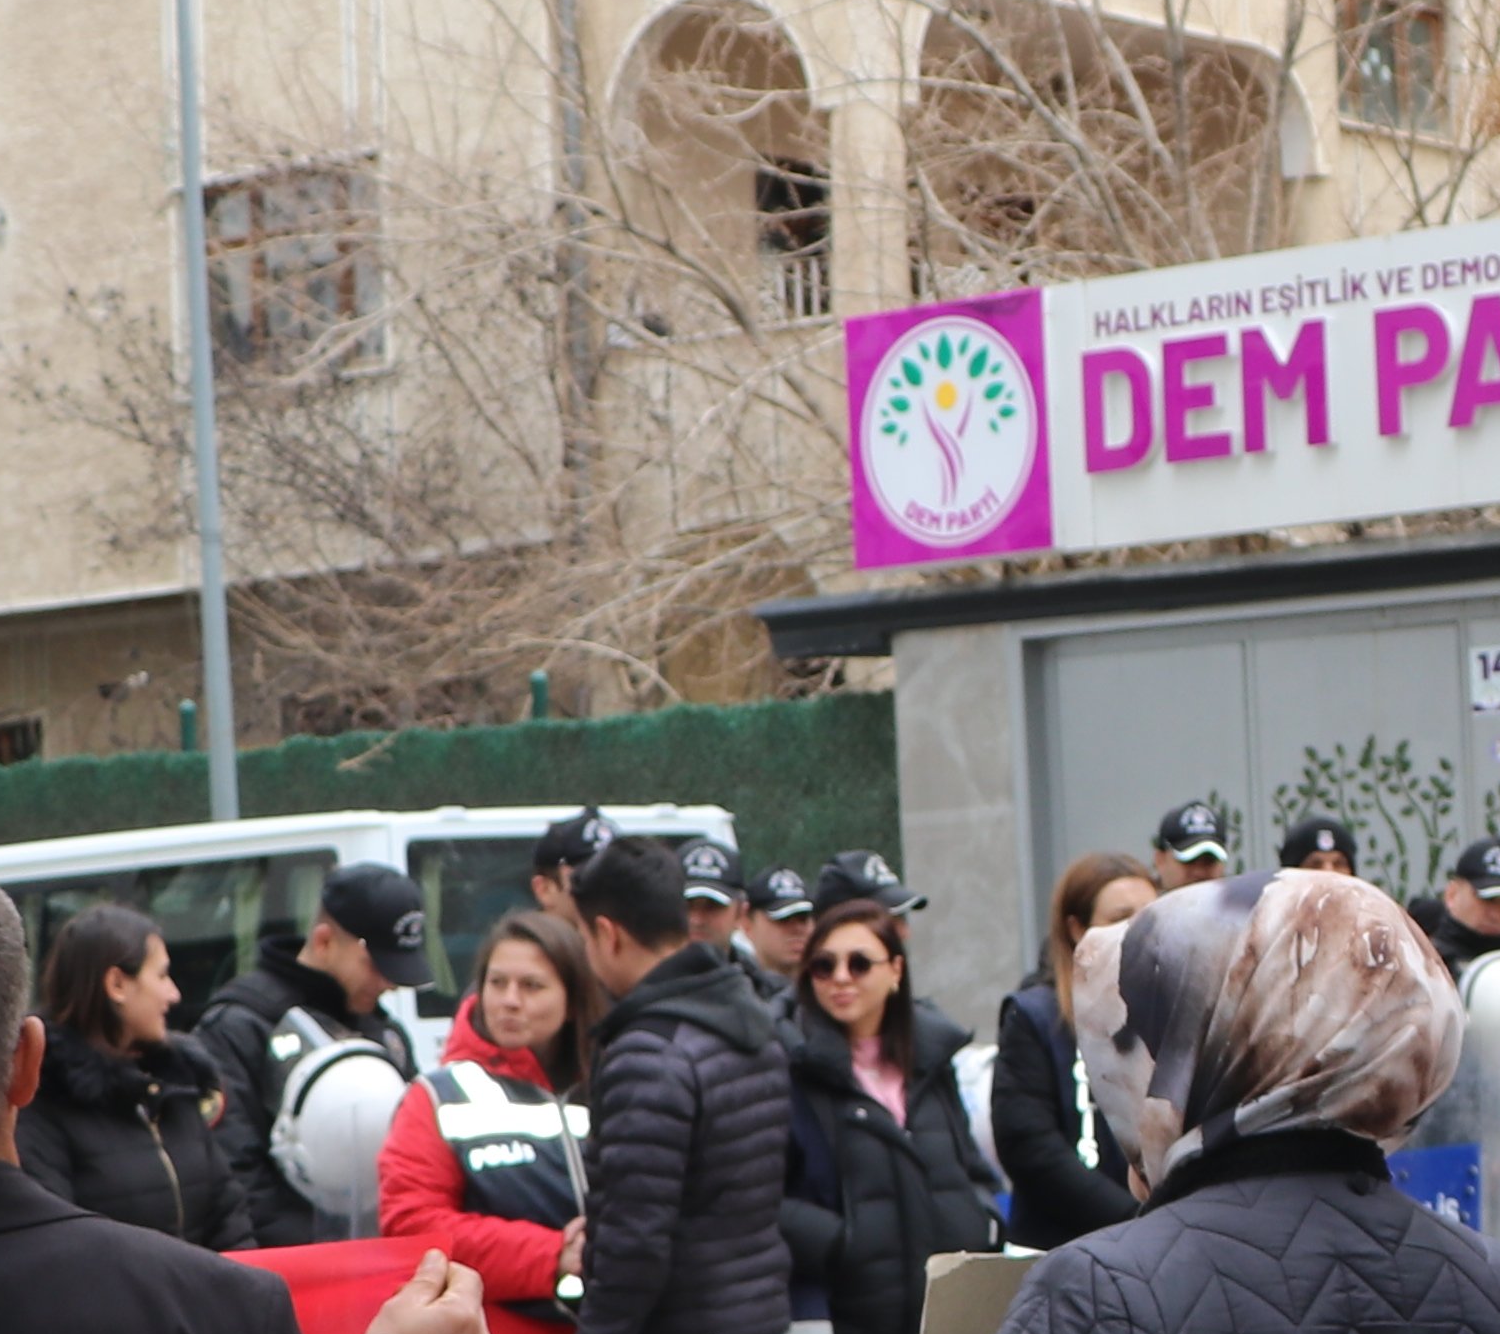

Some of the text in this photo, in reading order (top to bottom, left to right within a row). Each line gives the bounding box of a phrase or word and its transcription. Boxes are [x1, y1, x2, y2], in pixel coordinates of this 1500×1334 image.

[1094, 290, 1251, 337] HALKLARIN
[1260, 268, 1368, 315] EŞİTLİK
[1376, 266, 1413, 297] VE
[1082, 321, 1330, 473] DEM
[904, 499, 941, 532] DEM
